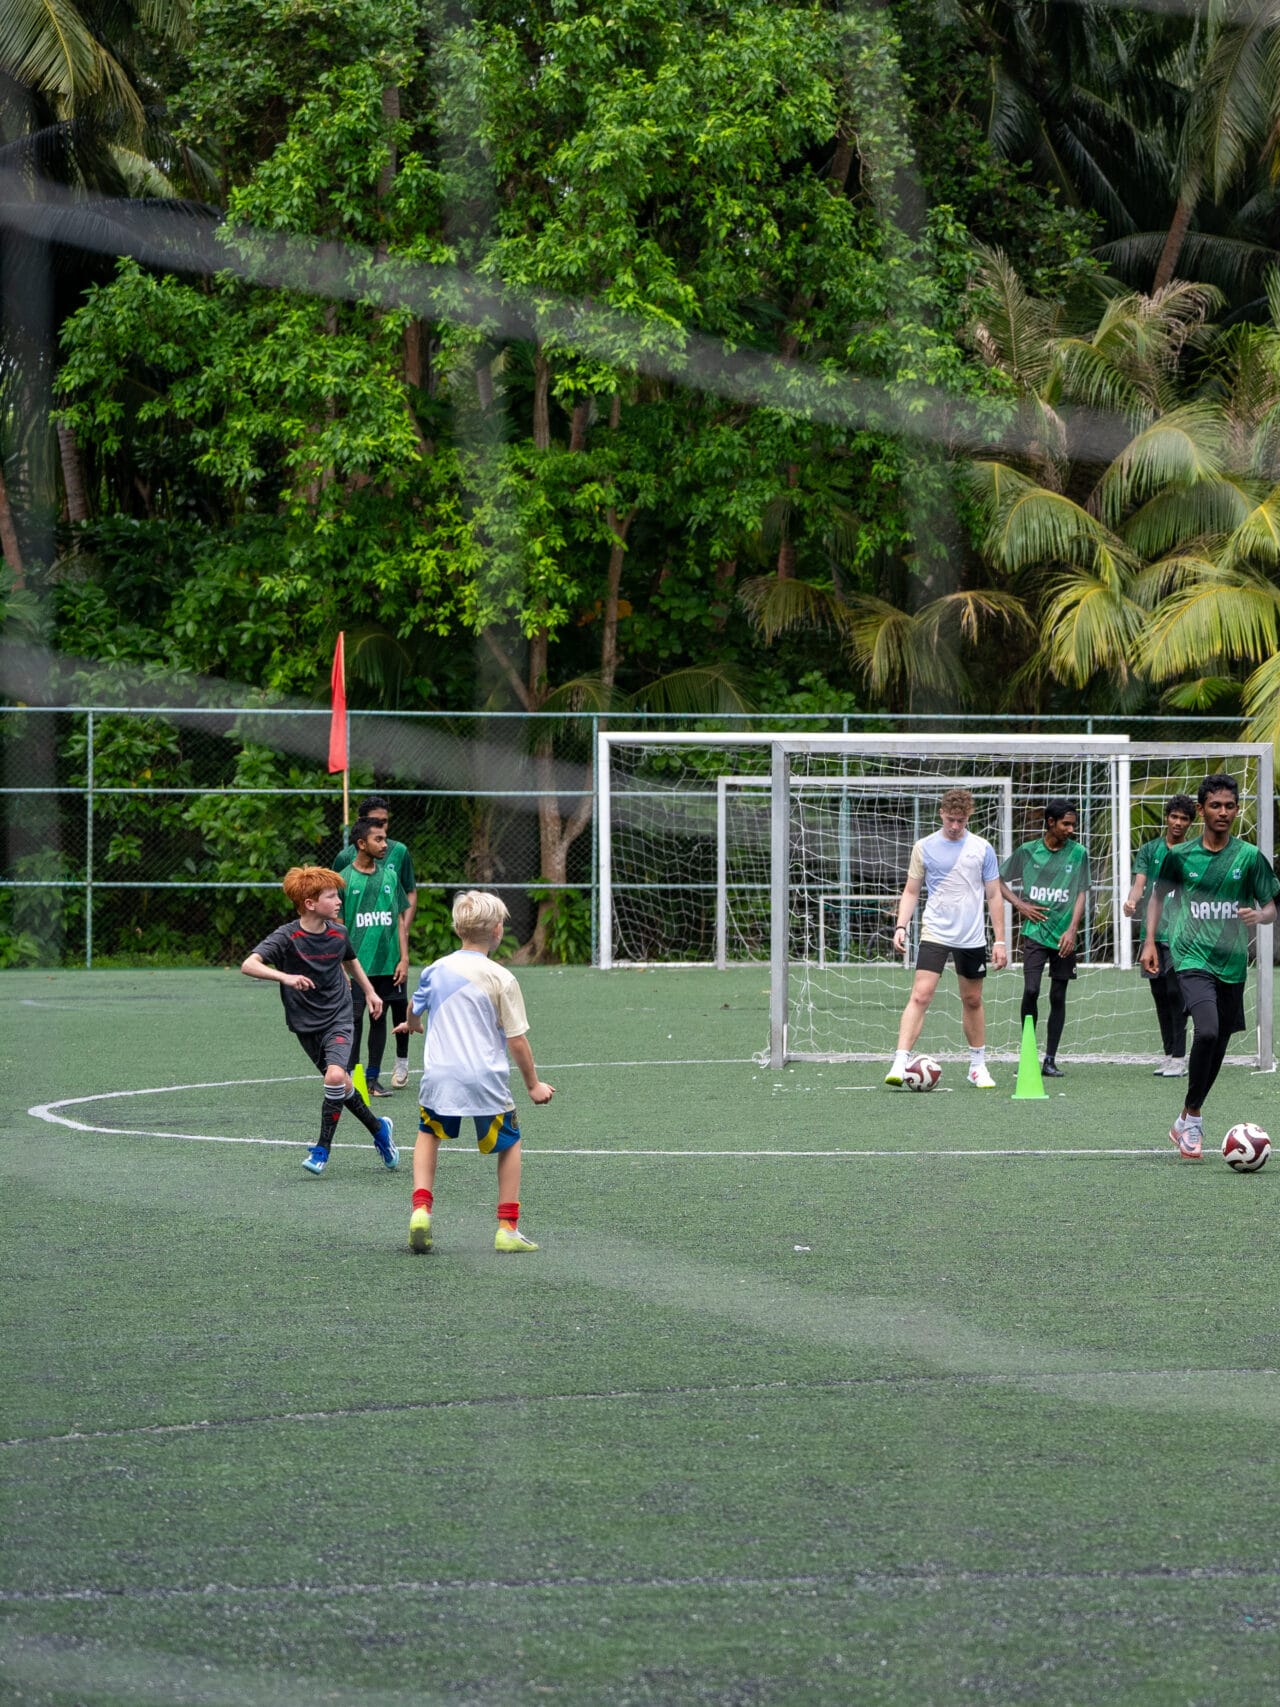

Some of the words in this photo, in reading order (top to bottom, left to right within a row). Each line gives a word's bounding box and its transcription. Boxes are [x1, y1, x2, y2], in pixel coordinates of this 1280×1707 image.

[1029, 885, 1070, 903] DAYAS
[1190, 900, 1239, 920] DAYAS
[356, 911, 393, 928] DAYAS
